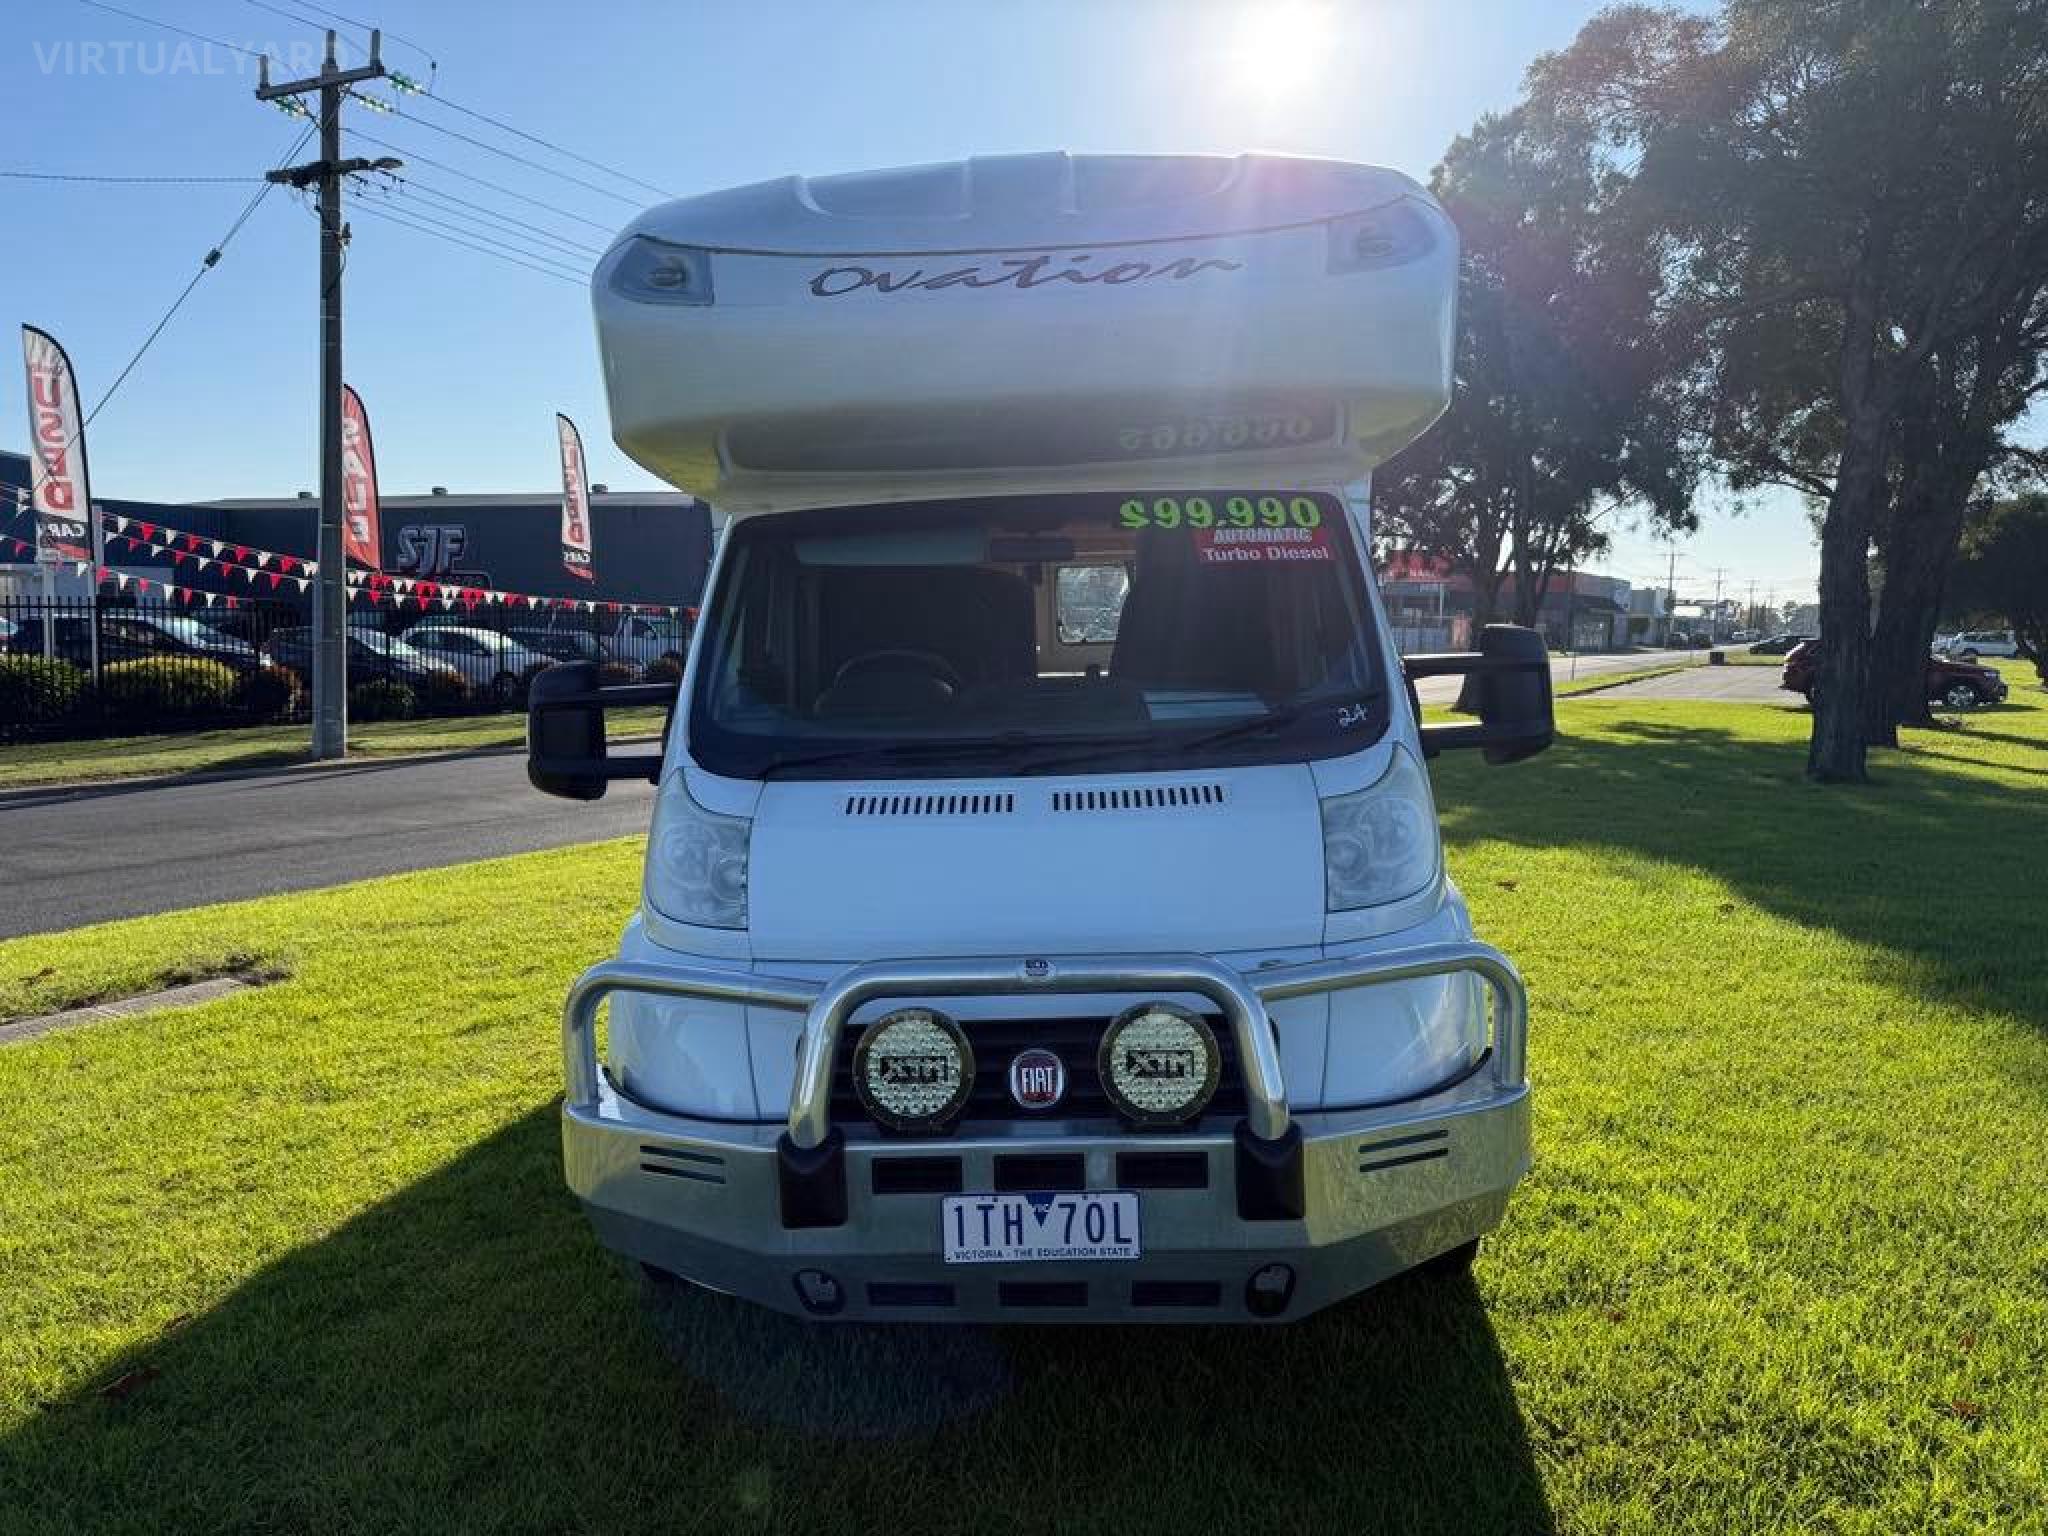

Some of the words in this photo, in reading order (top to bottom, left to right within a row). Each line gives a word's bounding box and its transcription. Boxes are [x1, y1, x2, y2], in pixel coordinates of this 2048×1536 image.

[809, 255, 1243, 297] Ovation
[1214, 527, 1313, 544] AUTOMATIC
[397, 525, 466, 573] SJF
[1201, 546, 1261, 561] Turbo
[1265, 545, 1329, 561] Diesel
[1021, 1067, 1053, 1093] FIAT
[954, 1203, 1024, 1247] 1TH
[1057, 1201, 1133, 1245] 70L
[953, 1249, 1005, 1260] VICTORIA
[1013, 1247, 1033, 1258] THE
[1037, 1247, 1097, 1257] EDUCATION
[1100, 1247, 1132, 1257] STATE
